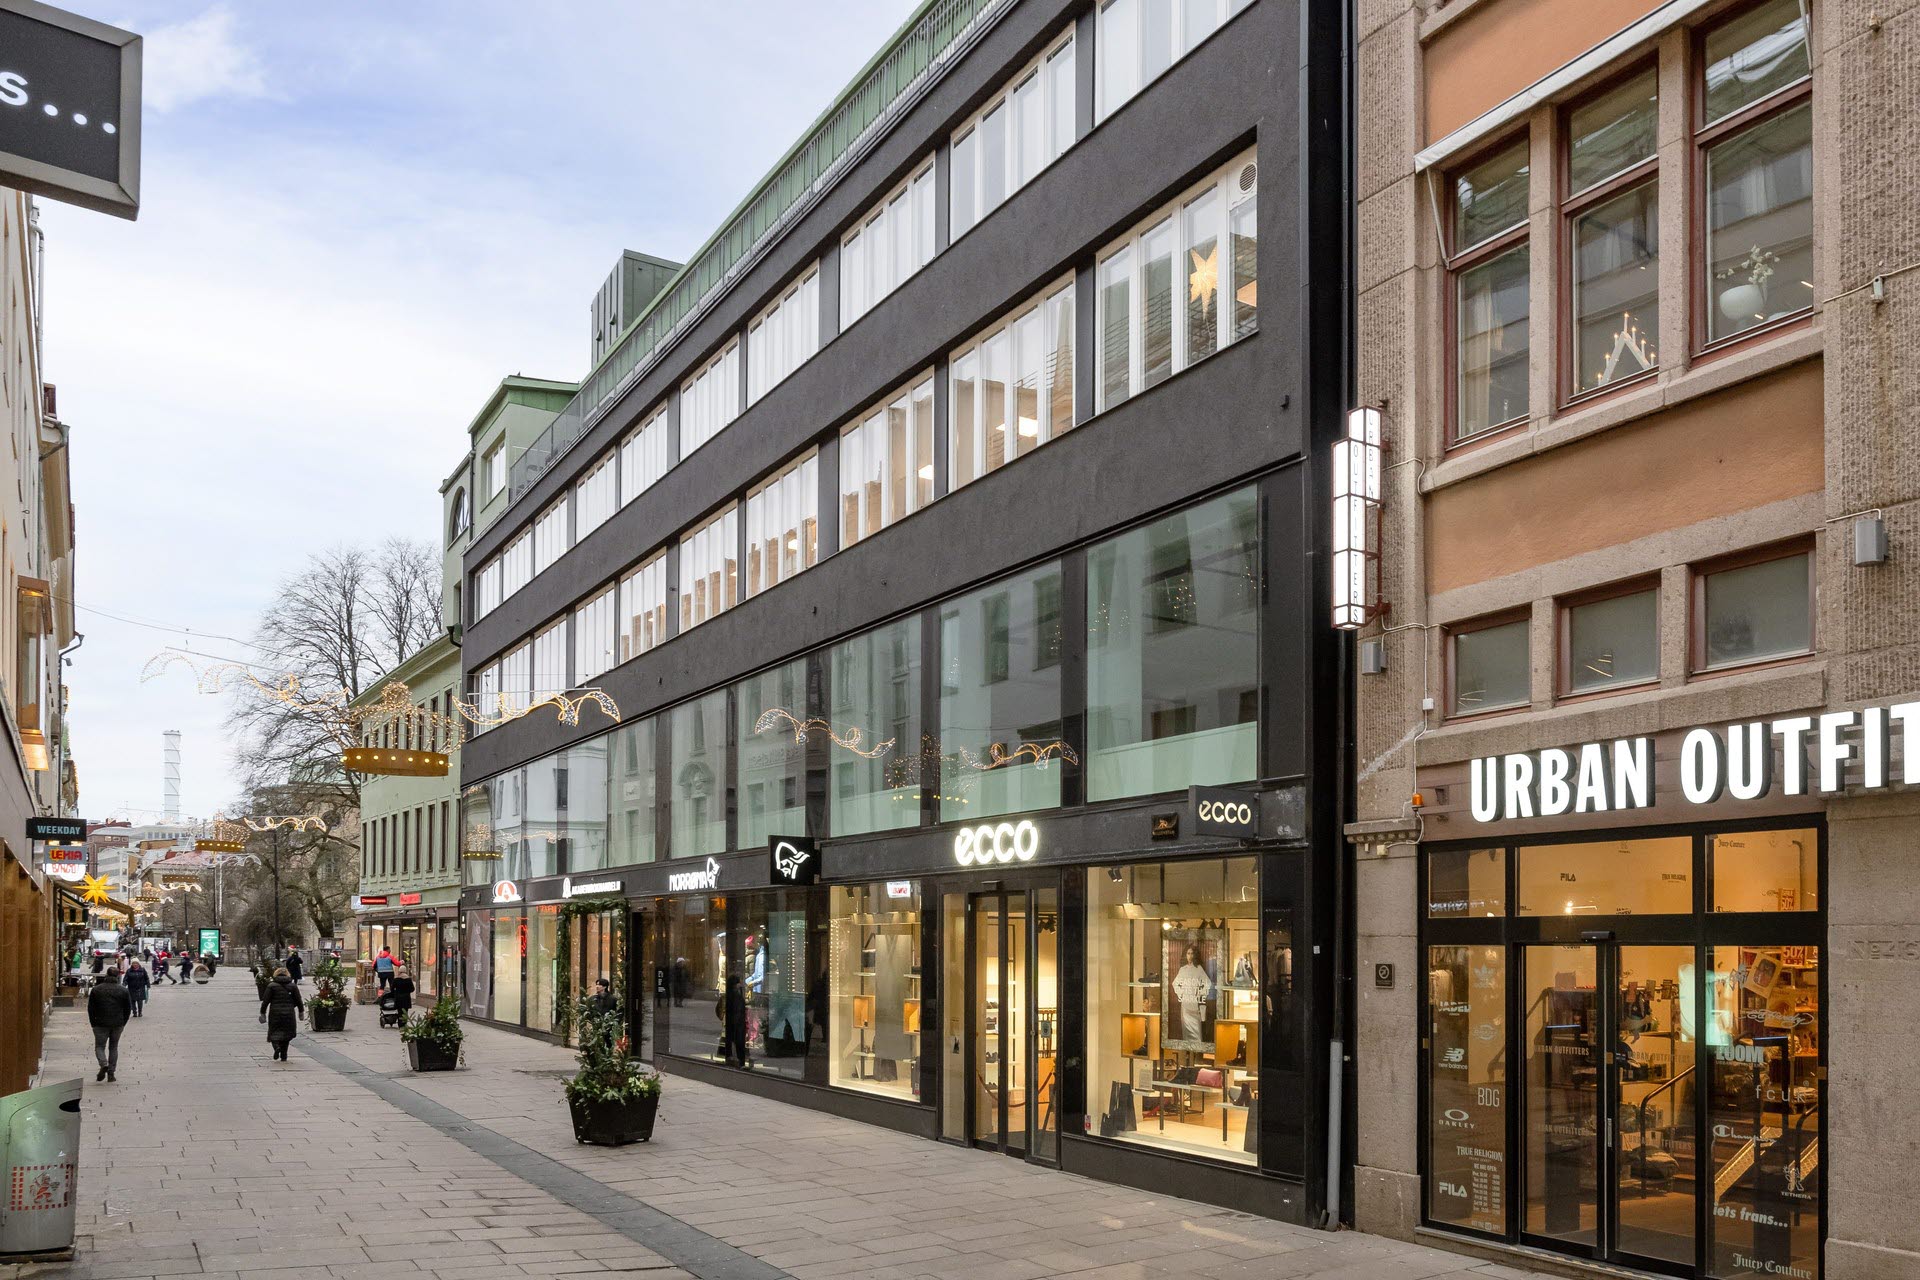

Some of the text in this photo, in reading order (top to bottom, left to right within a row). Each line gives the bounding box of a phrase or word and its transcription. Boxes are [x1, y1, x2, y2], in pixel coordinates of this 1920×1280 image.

[1470, 701, 1920, 822] URBAN OUTFIT
[1199, 800, 1251, 825] ecco
[37, 825, 81, 835] WEEKDAY
[954, 820, 1039, 865] ecco
[1560, 872, 1576, 882] FILA
[1783, 945, 1804, 959] 50%
[1554, 1045, 1590, 1056] OUTFITTERS
[1477, 1087, 1500, 1107] BDG
[1438, 1119, 1475, 1129] OAKLEY
[1456, 1145, 1473, 1156] TRUE
[1474, 1147, 1503, 1162] RELIGION
[1439, 1181, 1468, 1198] FILA
[1781, 1191, 1812, 1200] TETHERA
[1713, 1201, 1788, 1228] iets frans...
[1732, 1252, 1812, 1280] Juicy Couture
